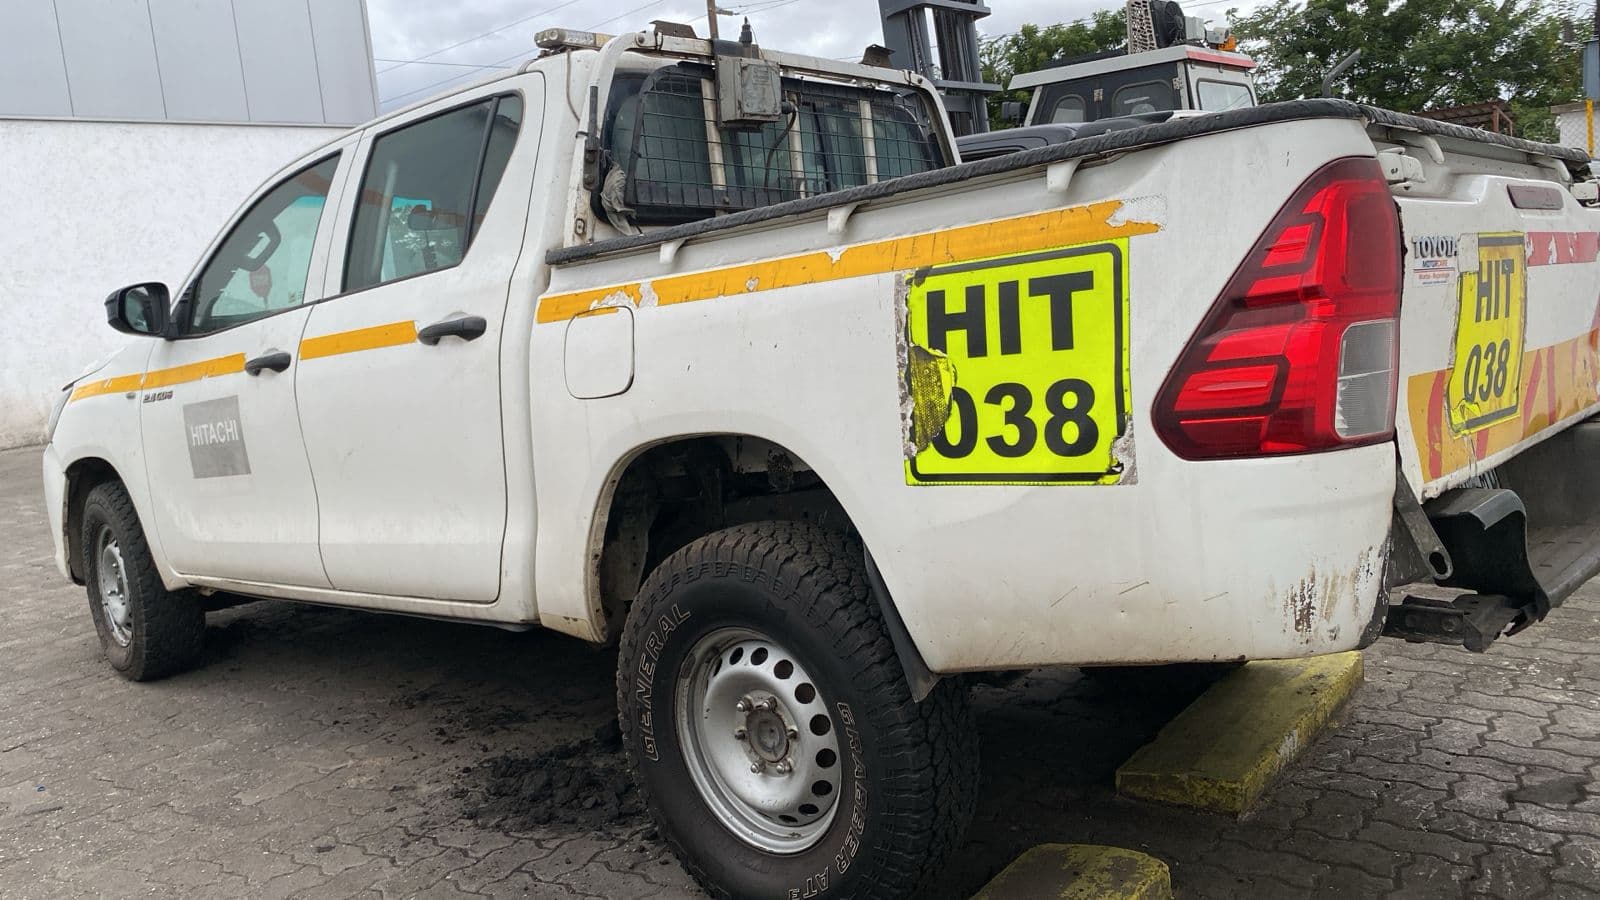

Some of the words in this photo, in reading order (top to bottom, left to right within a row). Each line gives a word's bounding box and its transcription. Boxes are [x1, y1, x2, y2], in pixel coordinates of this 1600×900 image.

[926, 271, 1094, 358] HIT
[1475, 258, 1514, 323] HIT
[1463, 338, 1511, 403] 038
[191, 419, 239, 447] HITACHI
[931, 378, 1099, 458] 038
[635, 603, 691, 761] GENERAL
[835, 702, 868, 875] GRABBER
